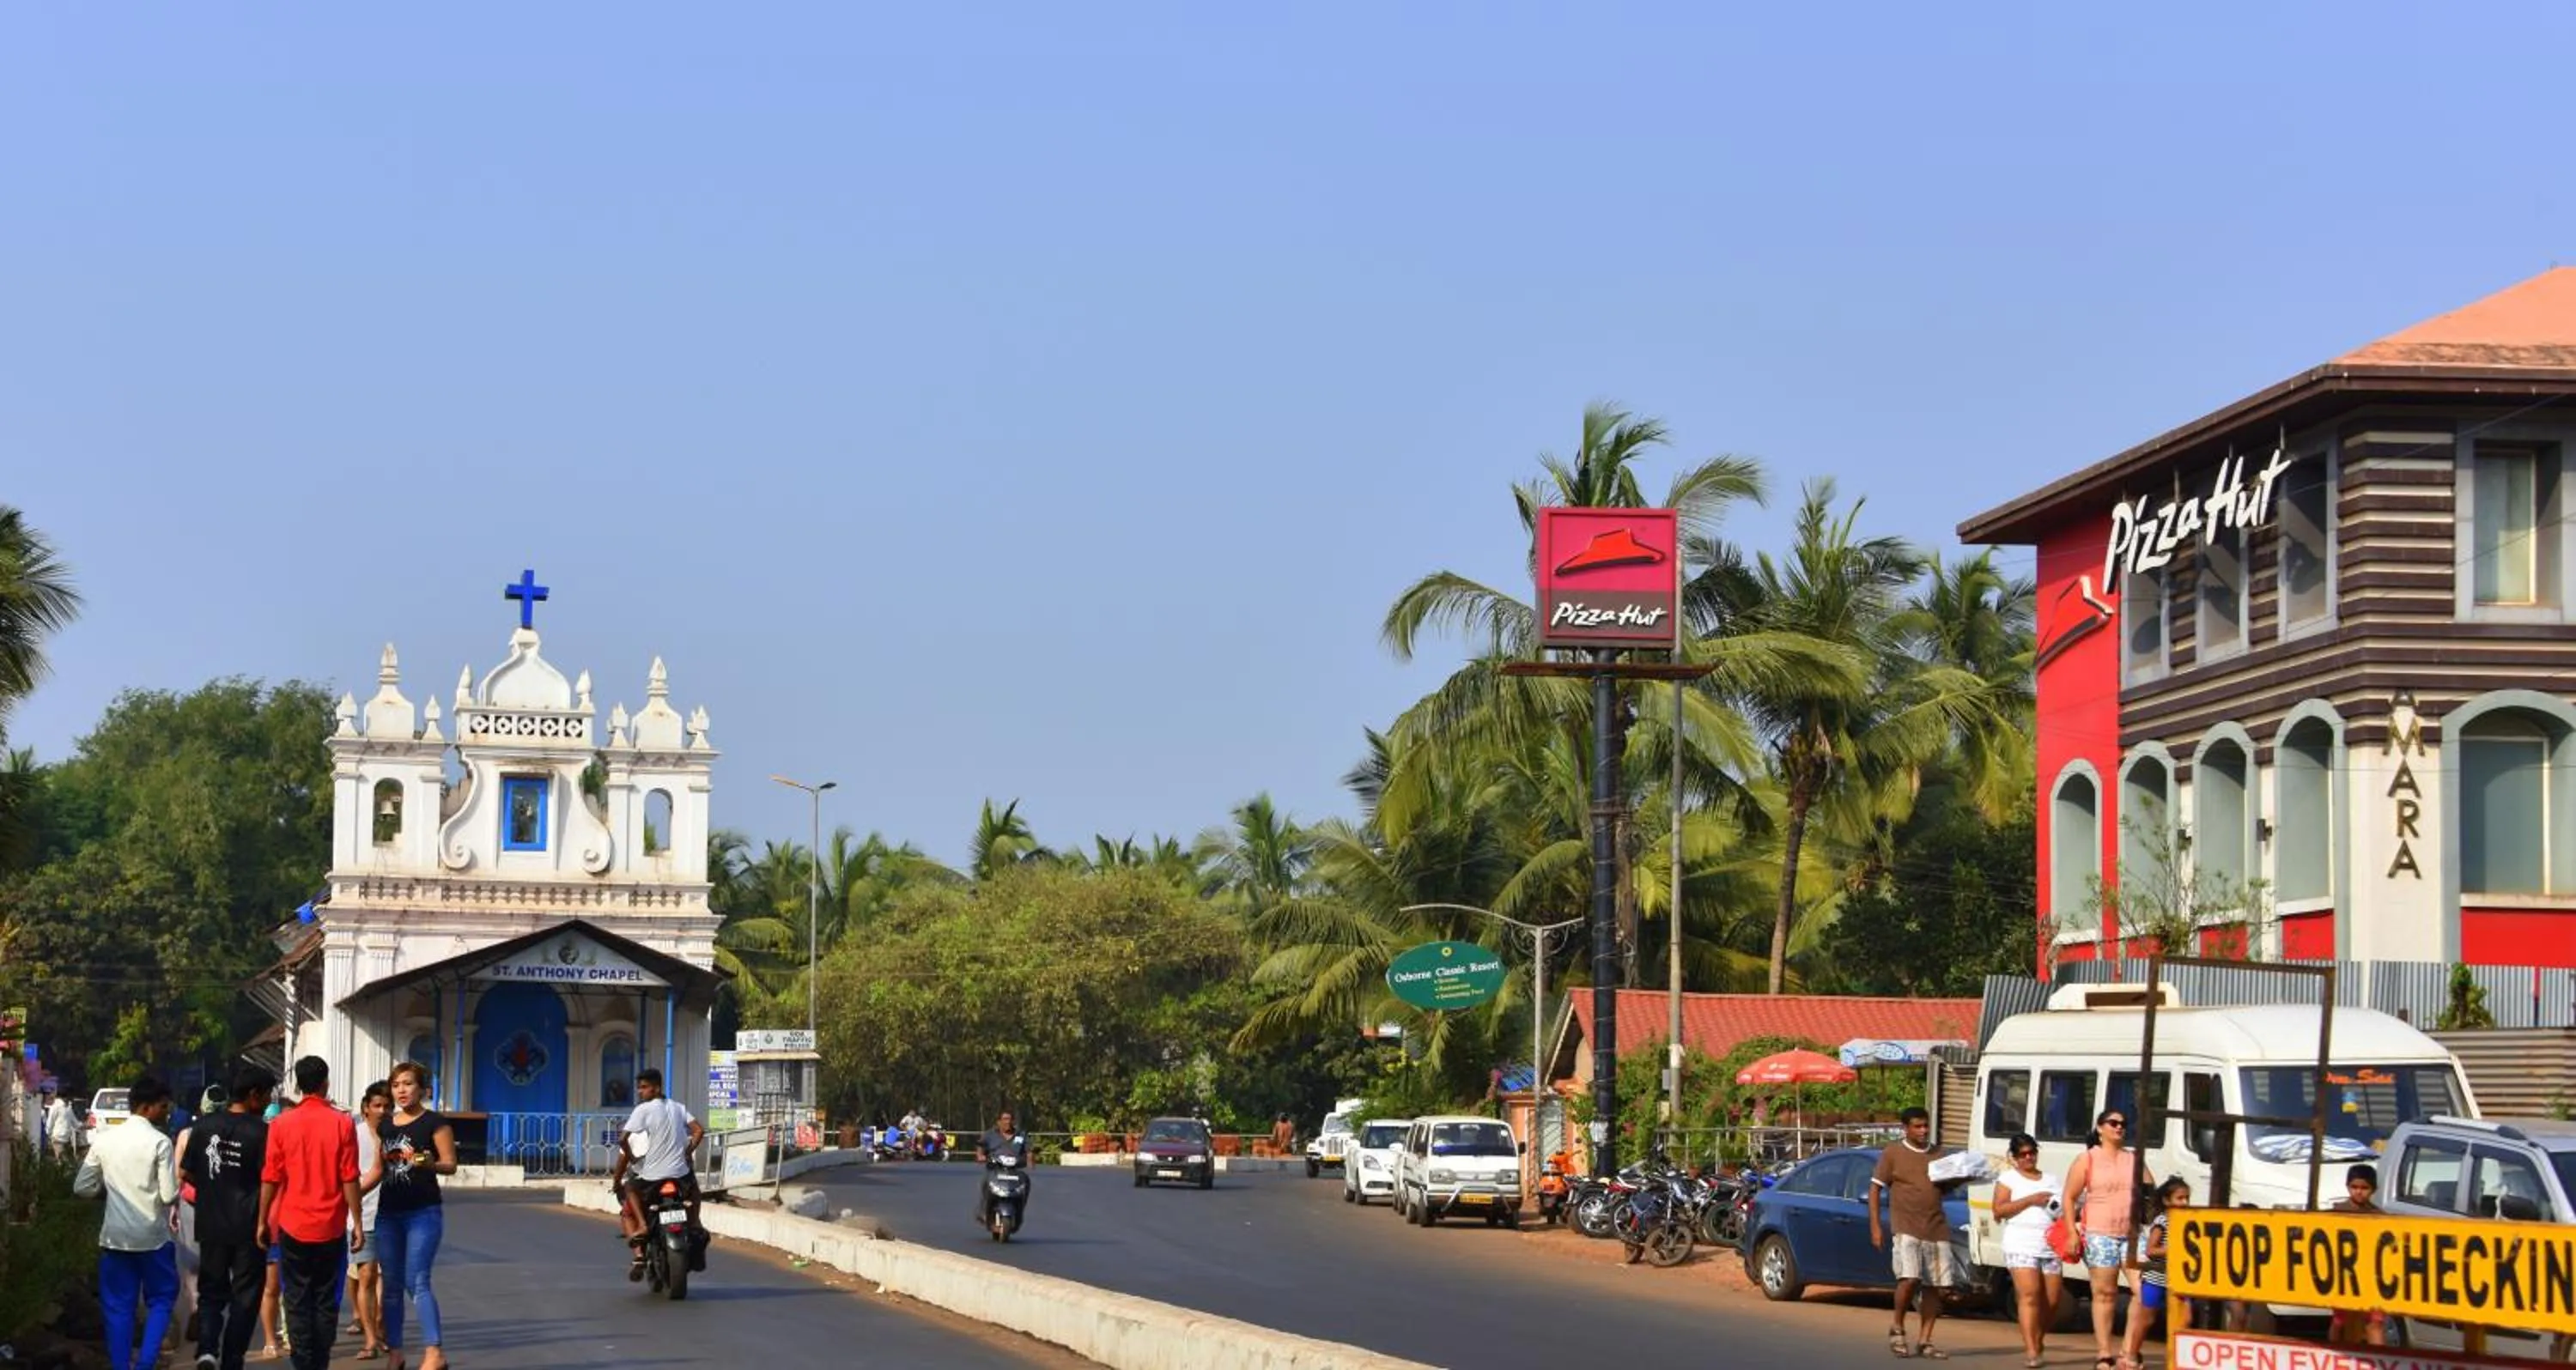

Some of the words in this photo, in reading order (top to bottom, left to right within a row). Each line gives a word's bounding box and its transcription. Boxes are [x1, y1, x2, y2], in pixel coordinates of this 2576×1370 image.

[2104, 494, 2202, 594] Pizza
[2204, 449, 2291, 545] Hut
[1551, 602, 1616, 627] Pizza
[1619, 603, 1668, 626] Hut
[2382, 686, 2426, 879] AMARA
[492, 965, 512, 976] ST.
[516, 966, 585, 979] ANTHONY
[589, 968, 643, 981] CHAPEL
[1394, 971, 1432, 983] Osborne
[1435, 965, 1466, 977] Classic
[1470, 961, 1498, 973] Resort
[2182, 1220, 2271, 1288] STOP
[2287, 1225, 2360, 1297] FOR
[2192, 1341, 2277, 1370] OPEN
